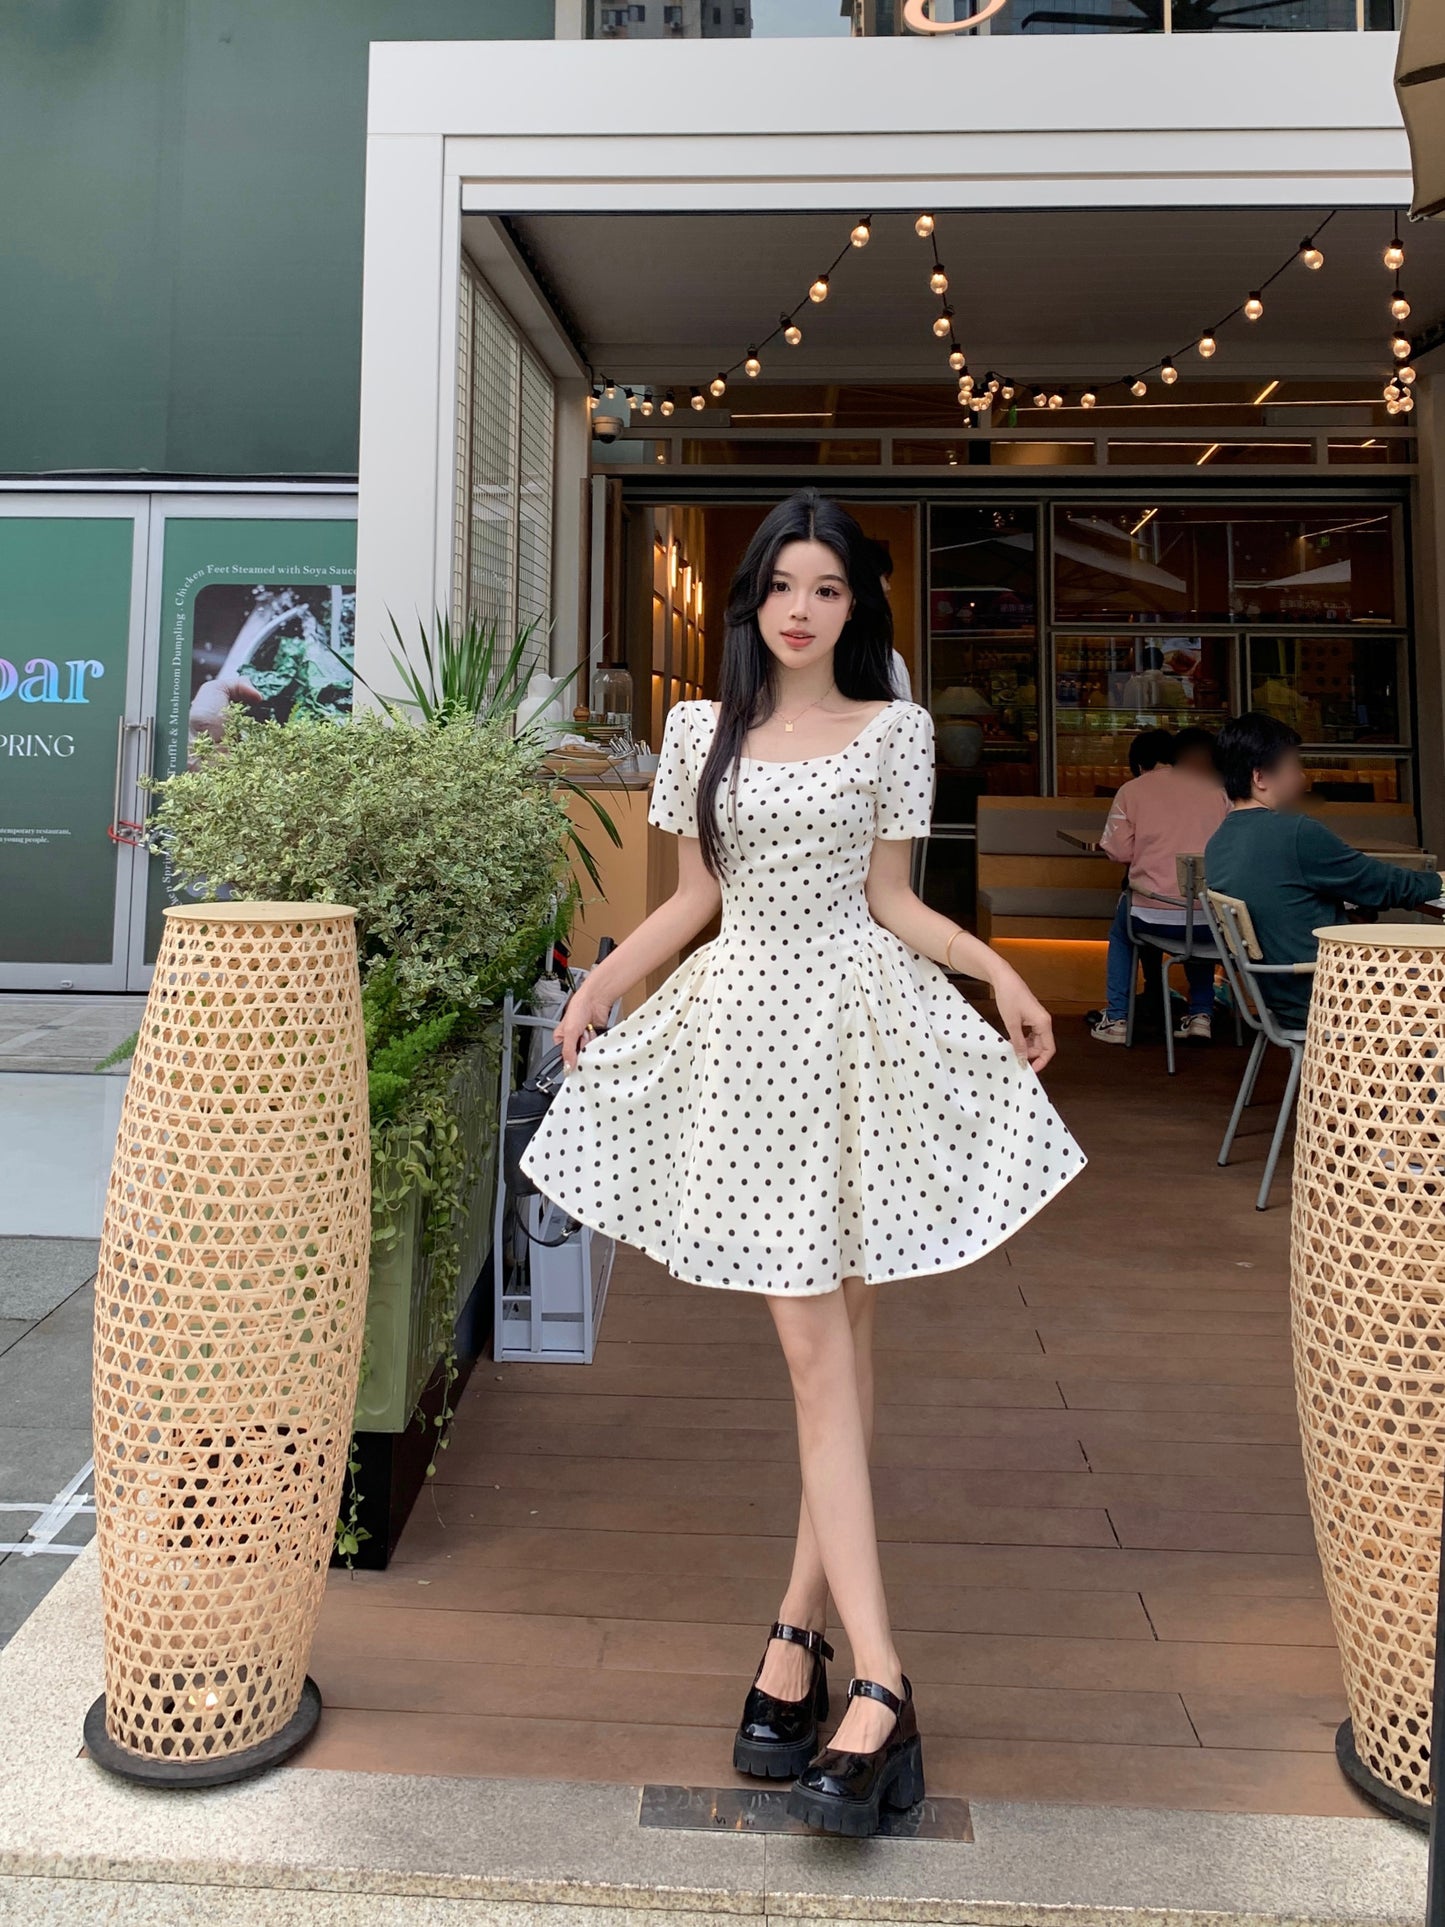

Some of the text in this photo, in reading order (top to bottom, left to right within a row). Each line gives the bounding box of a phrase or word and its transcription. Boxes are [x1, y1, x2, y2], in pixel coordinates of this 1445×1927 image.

[206, 564, 229, 575] Feet
[232, 565, 275, 575] Steamed
[278, 565, 300, 575] with
[303, 566, 327, 577] Soya
[175, 569, 205, 605] Chicken
[172, 613, 185, 666] Dumpling
[169, 668, 181, 724] Mushroom
[169, 728, 178, 736] &
[167, 738, 178, 777] Truffle
